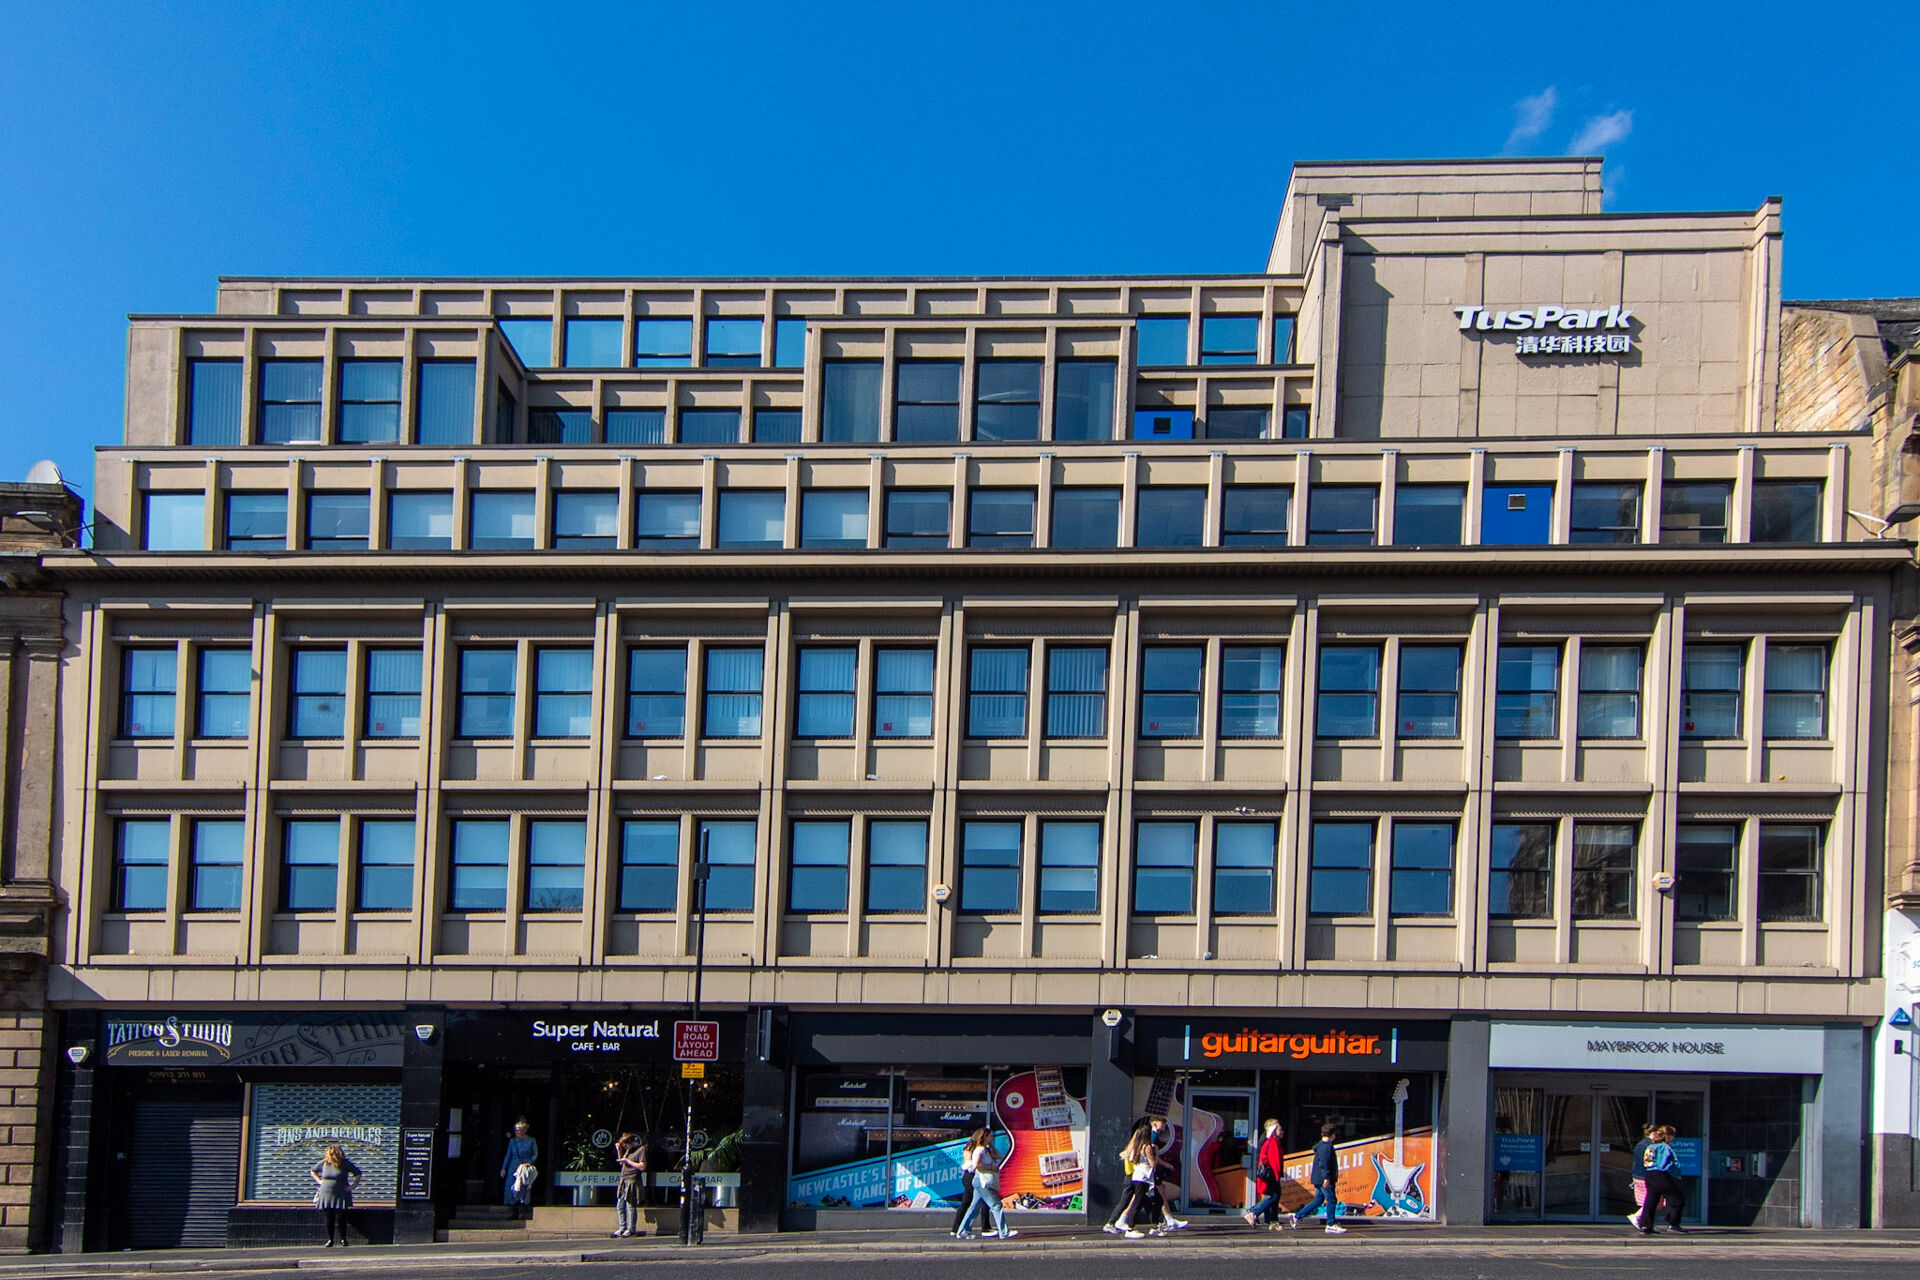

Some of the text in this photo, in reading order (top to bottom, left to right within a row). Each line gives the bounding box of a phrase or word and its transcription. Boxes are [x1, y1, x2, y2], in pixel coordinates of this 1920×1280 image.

[1454, 304, 1634, 330] TusPark
[1516, 335, 1630, 353] 清华科技园
[107, 1016, 232, 1047] TATTOO STUDIO
[532, 1020, 659, 1042] Super Natural
[685, 1024, 708, 1032] NEW
[683, 1032, 710, 1040] ROAD
[571, 1042, 620, 1051] CAFE BAR
[678, 1040, 715, 1048] LAYOUT
[1587, 1040, 1725, 1054] MAYBROOK HOUSE
[679, 1049, 713, 1057] AHEAD
[839, 1081, 867, 1089] Marshall
[940, 1111, 972, 1121] Marshall
[277, 1127, 382, 1146] PINS AND NEEDLES
[798, 1155, 936, 1197] NEWCASTLE'S LARGEST
[896, 1177, 913, 1192] OF
[914, 1166, 964, 1188] GUITARS
